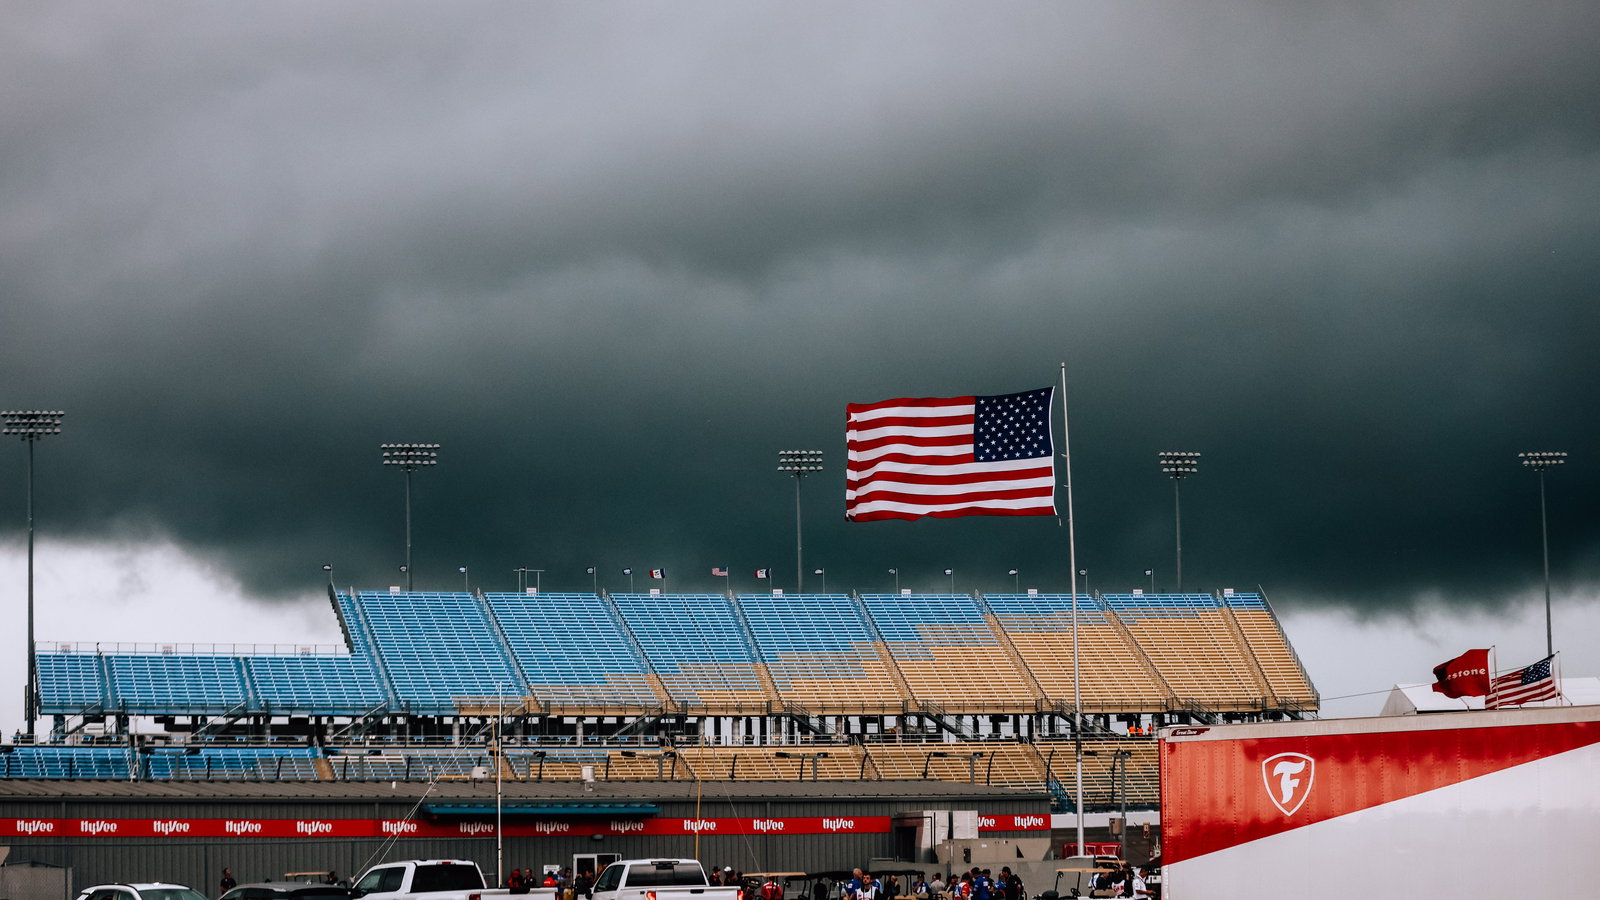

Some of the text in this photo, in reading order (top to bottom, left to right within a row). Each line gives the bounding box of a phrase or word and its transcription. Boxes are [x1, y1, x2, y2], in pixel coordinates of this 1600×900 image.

[1446, 668, 1486, 680] estone
[17, 820, 53, 835] HyVee
[81, 820, 117, 835] HyVee
[154, 820, 189, 835] HyVee
[226, 820, 261, 835] HyVee
[297, 820, 332, 835] HyVee
[382, 820, 417, 835] HyVee
[460, 822, 493, 834] HyVee
[536, 822, 569, 834] HyVee
[611, 821, 643, 833] HyVee
[684, 818, 716, 832] HyVee
[753, 819, 784, 833] HyVee
[823, 818, 854, 832] HyVee
[978, 817, 996, 828] Vee
[1014, 816, 1044, 829] HyVee
